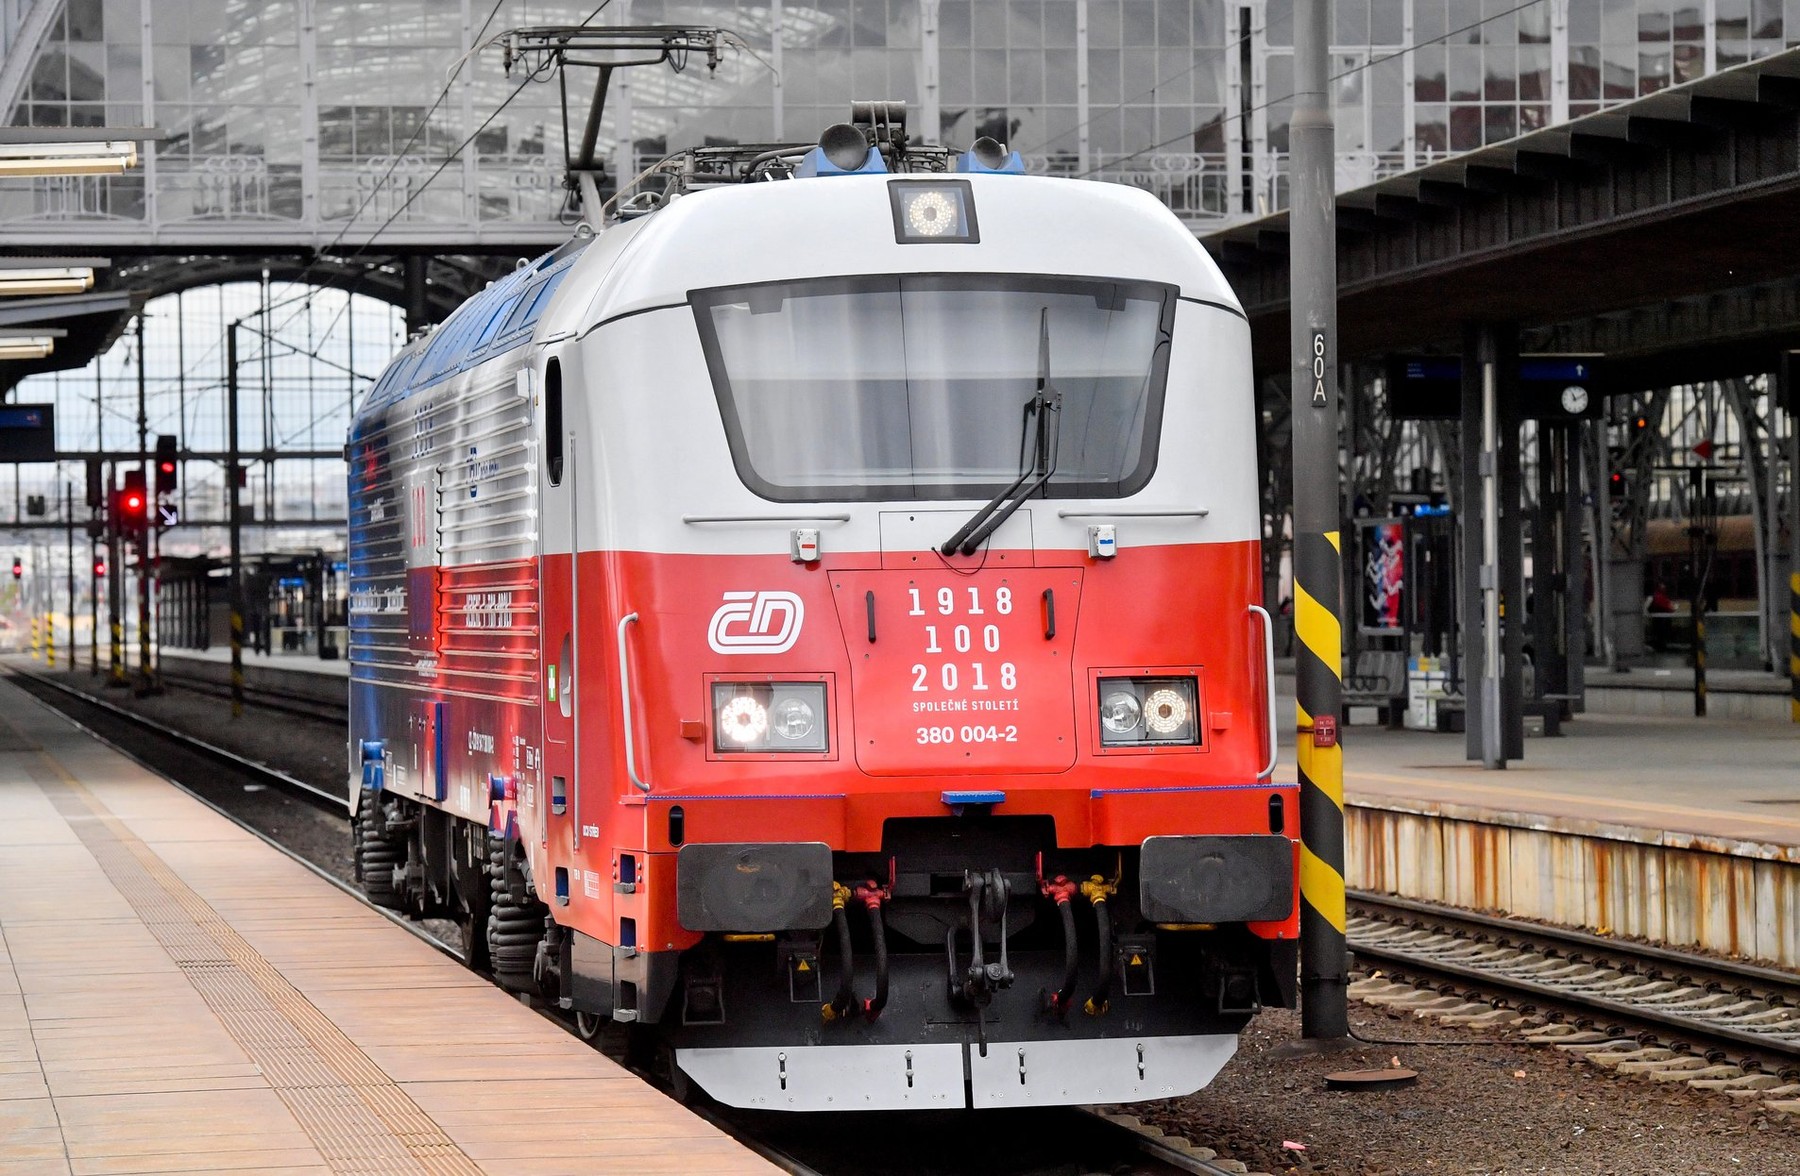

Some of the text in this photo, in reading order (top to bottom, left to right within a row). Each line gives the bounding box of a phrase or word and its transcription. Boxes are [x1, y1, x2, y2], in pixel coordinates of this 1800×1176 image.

[1313, 333, 1326, 401] 60A
[908, 586, 1013, 616] 1918
[707, 590, 805, 655] ČD
[925, 624, 1000, 653] 100
[911, 662, 1017, 691] 2018
[913, 698, 1019, 712] SPOLEČNÉ STOLETÍ
[916, 725, 1018, 744] 380 004-2
